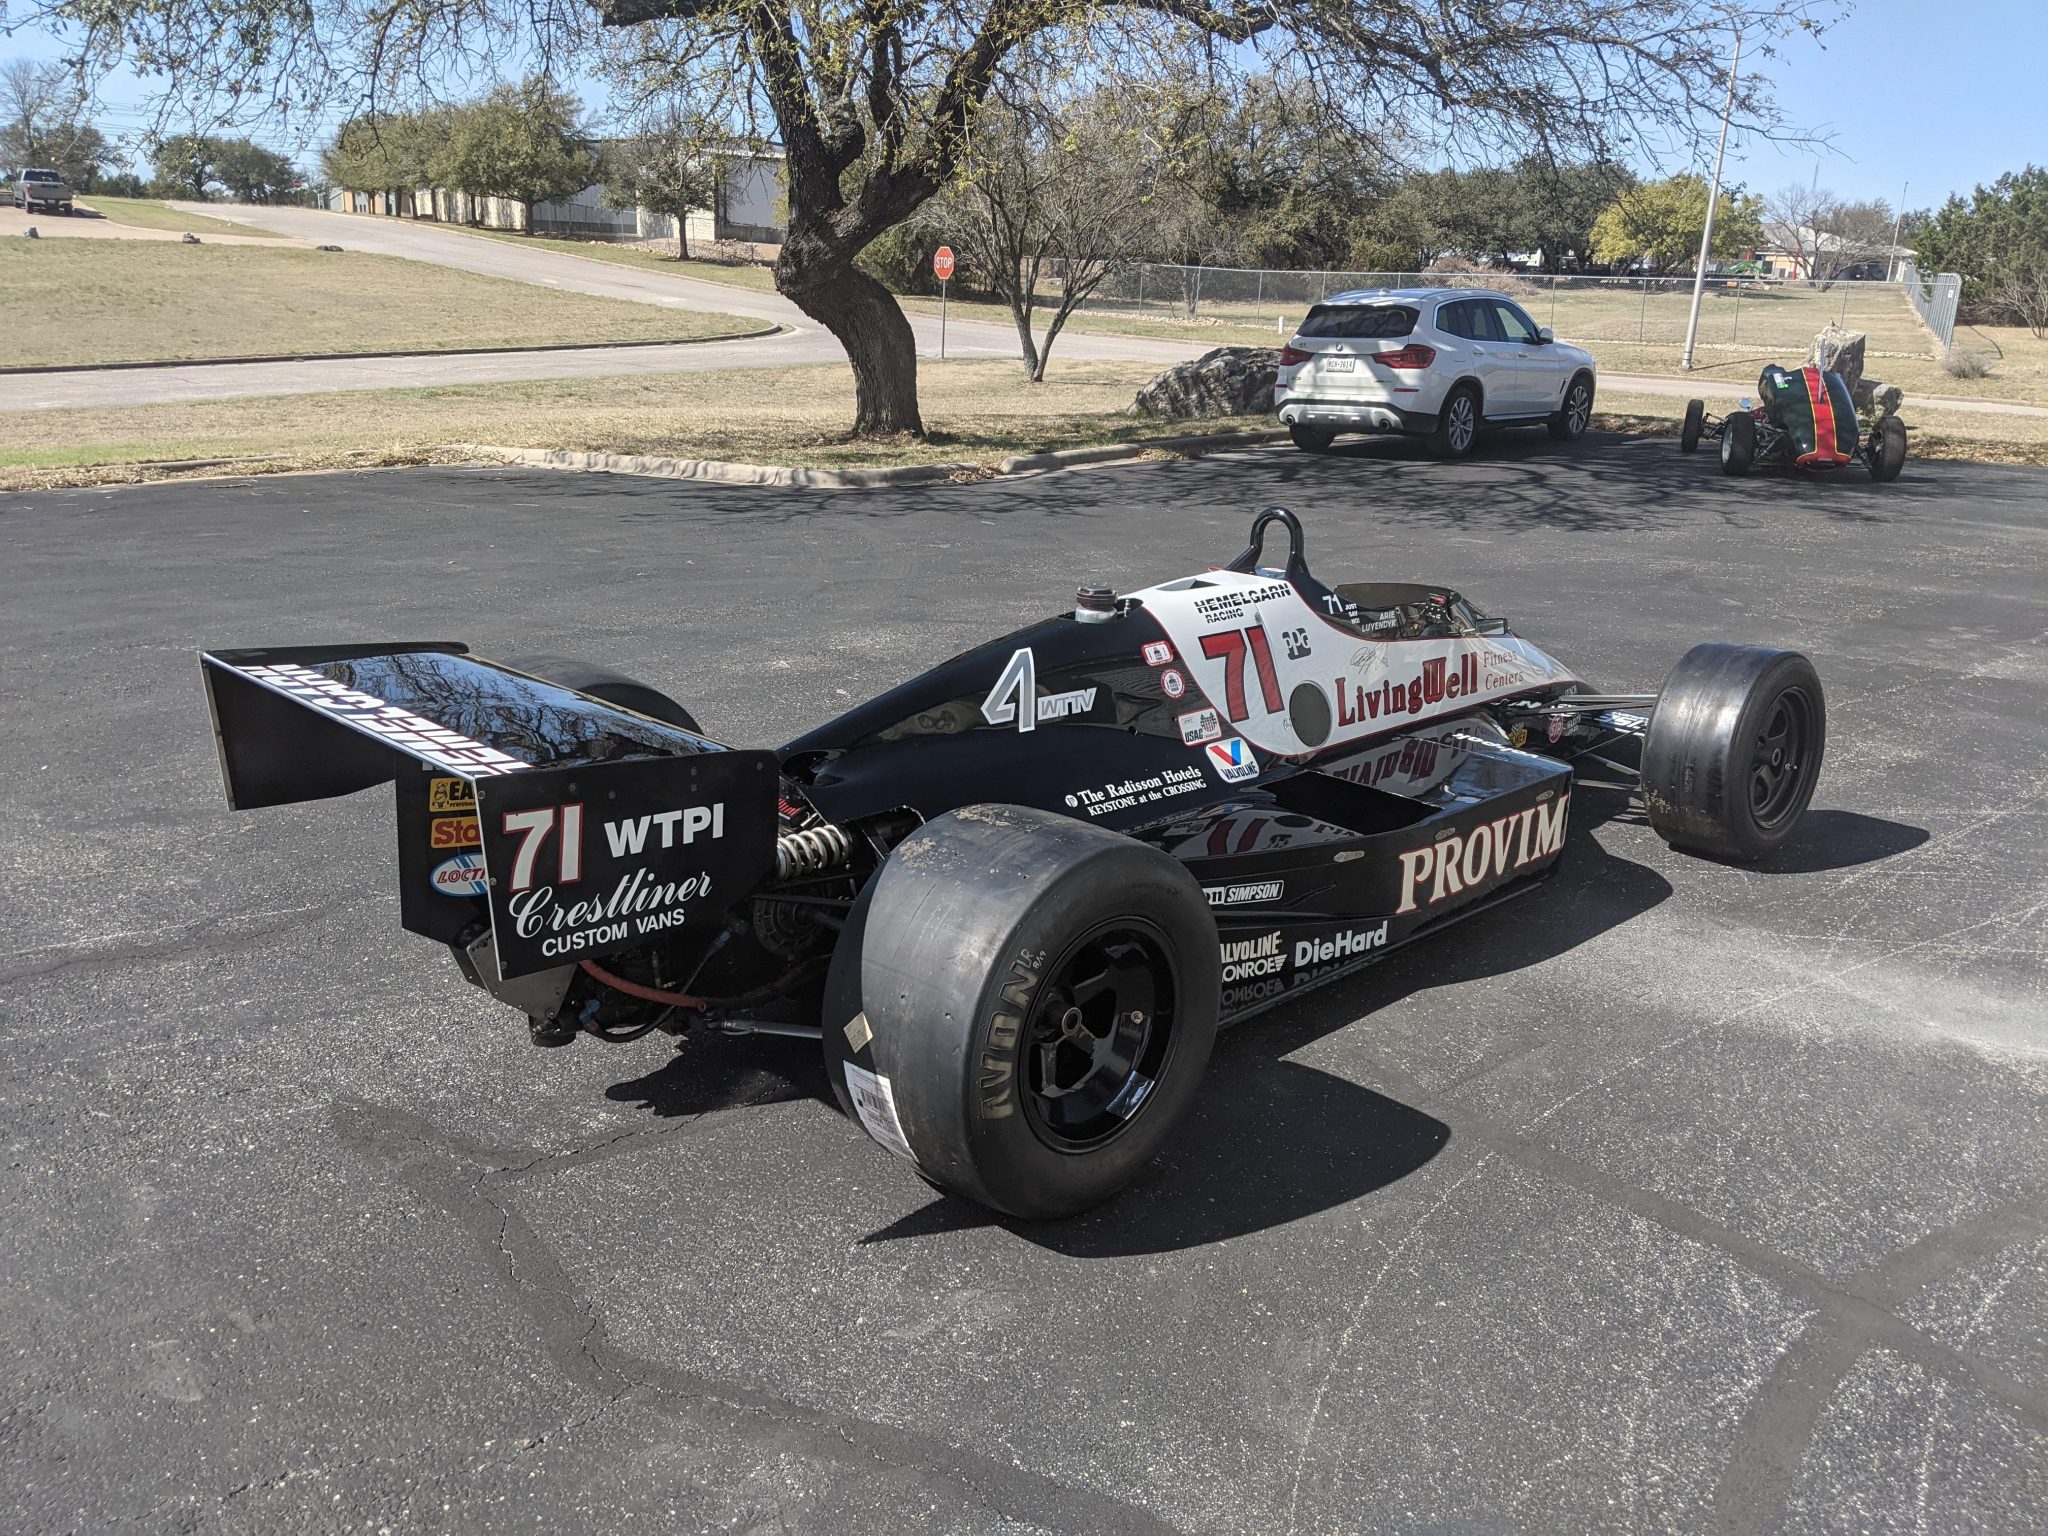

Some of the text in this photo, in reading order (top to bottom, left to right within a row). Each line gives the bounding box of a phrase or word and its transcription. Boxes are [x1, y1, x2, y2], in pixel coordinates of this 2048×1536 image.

[936, 256, 953, 268] STOP
[1194, 583, 1291, 613] HEMELGARN
[1322, 594, 1343, 614] 71
[1205, 608, 1244, 624] RACING
[1361, 619, 1396, 632] LUYENDYK
[1380, 610, 1396, 620] ARIE
[1198, 624, 1285, 723] 71
[1483, 650, 1517, 668] Fitness
[980, 647, 1035, 732] 4
[1485, 671, 1524, 690] Centers
[1038, 687, 1097, 720] WTTV
[1185, 728, 1203, 742] USAC
[1077, 789, 1105, 805] The
[1105, 777, 1163, 798] Radisson
[1162, 765, 1202, 784] Hotels
[1221, 761, 1258, 780] VALVOLINE
[1087, 796, 1138, 816] KEYSTONE
[1138, 795, 1148, 803] at
[1149, 791, 1162, 801] the
[1163, 779, 1207, 797] CROSSING
[604, 802, 724, 858] WTPI
[502, 802, 584, 893] 71
[509, 868, 713, 938] Crestliner
[1227, 883, 1281, 903] SIMPSON
[541, 908, 686, 957] CUSTOM VANS
[1294, 920, 1388, 967] DieHard
[1221, 957, 1277, 983] ONROE
[979, 960, 1039, 1120] AVON
